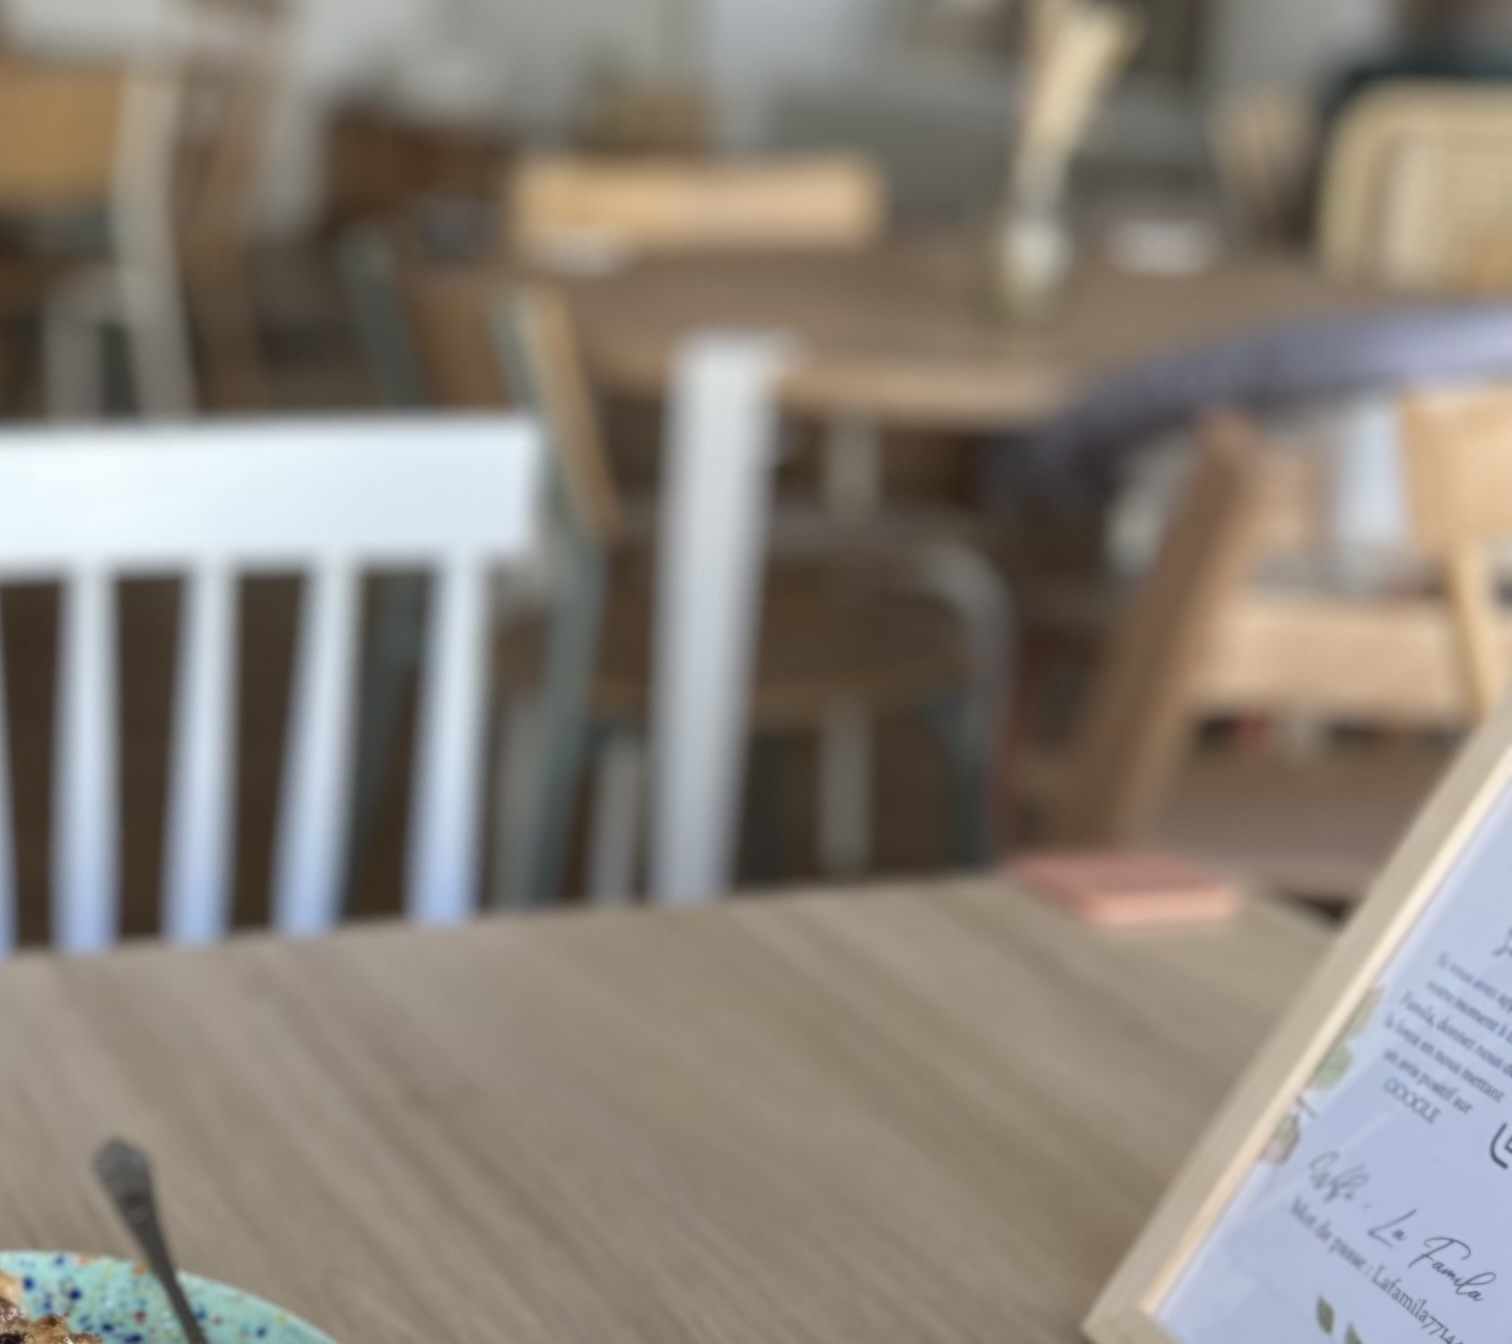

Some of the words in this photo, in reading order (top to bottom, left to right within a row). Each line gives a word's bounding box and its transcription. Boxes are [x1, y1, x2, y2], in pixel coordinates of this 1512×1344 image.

[1383, 1075, 1442, 1126] GOOGLE
[1461, 1068, 1505, 1104] mettant
[1367, 1208, 1417, 1249] La
[1407, 1235, 1497, 1303] Famila
